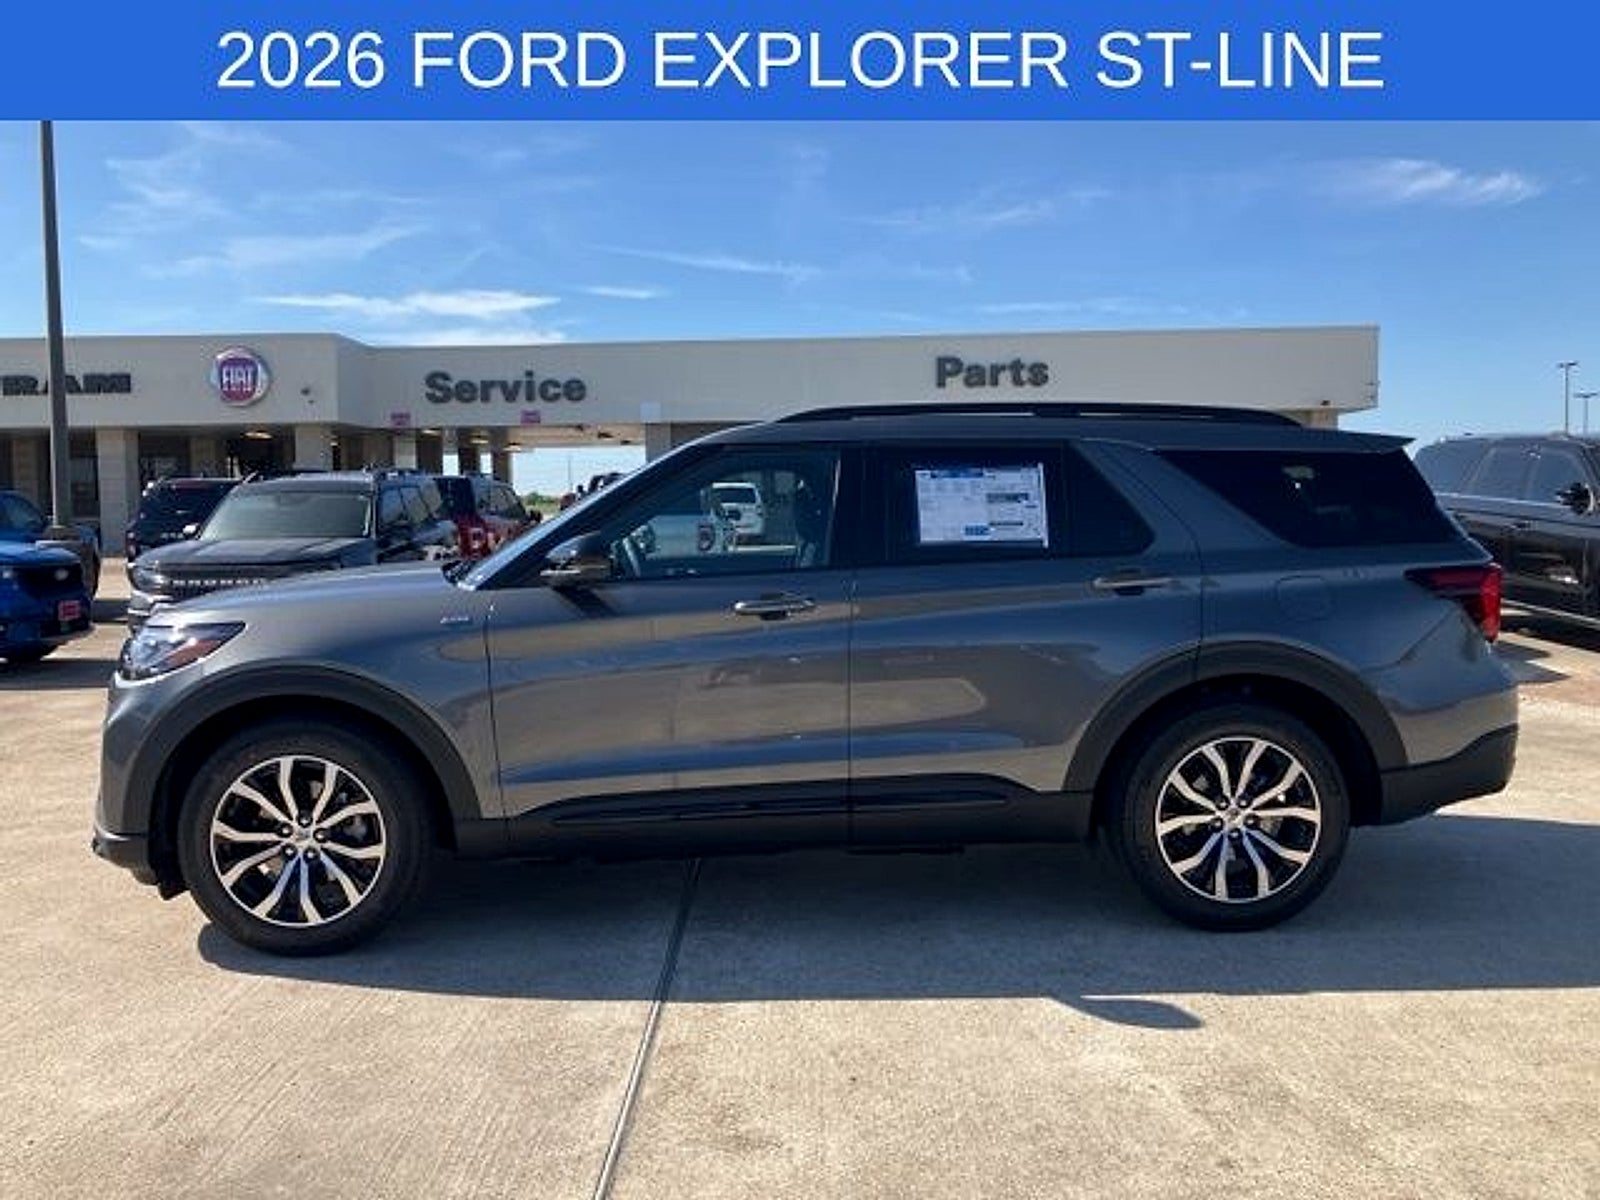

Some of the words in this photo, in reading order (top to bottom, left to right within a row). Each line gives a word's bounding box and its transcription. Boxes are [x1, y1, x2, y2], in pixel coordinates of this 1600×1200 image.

[221, 365, 255, 392] FIAT
[424, 370, 587, 404] Service
[935, 356, 1049, 388] Parts
